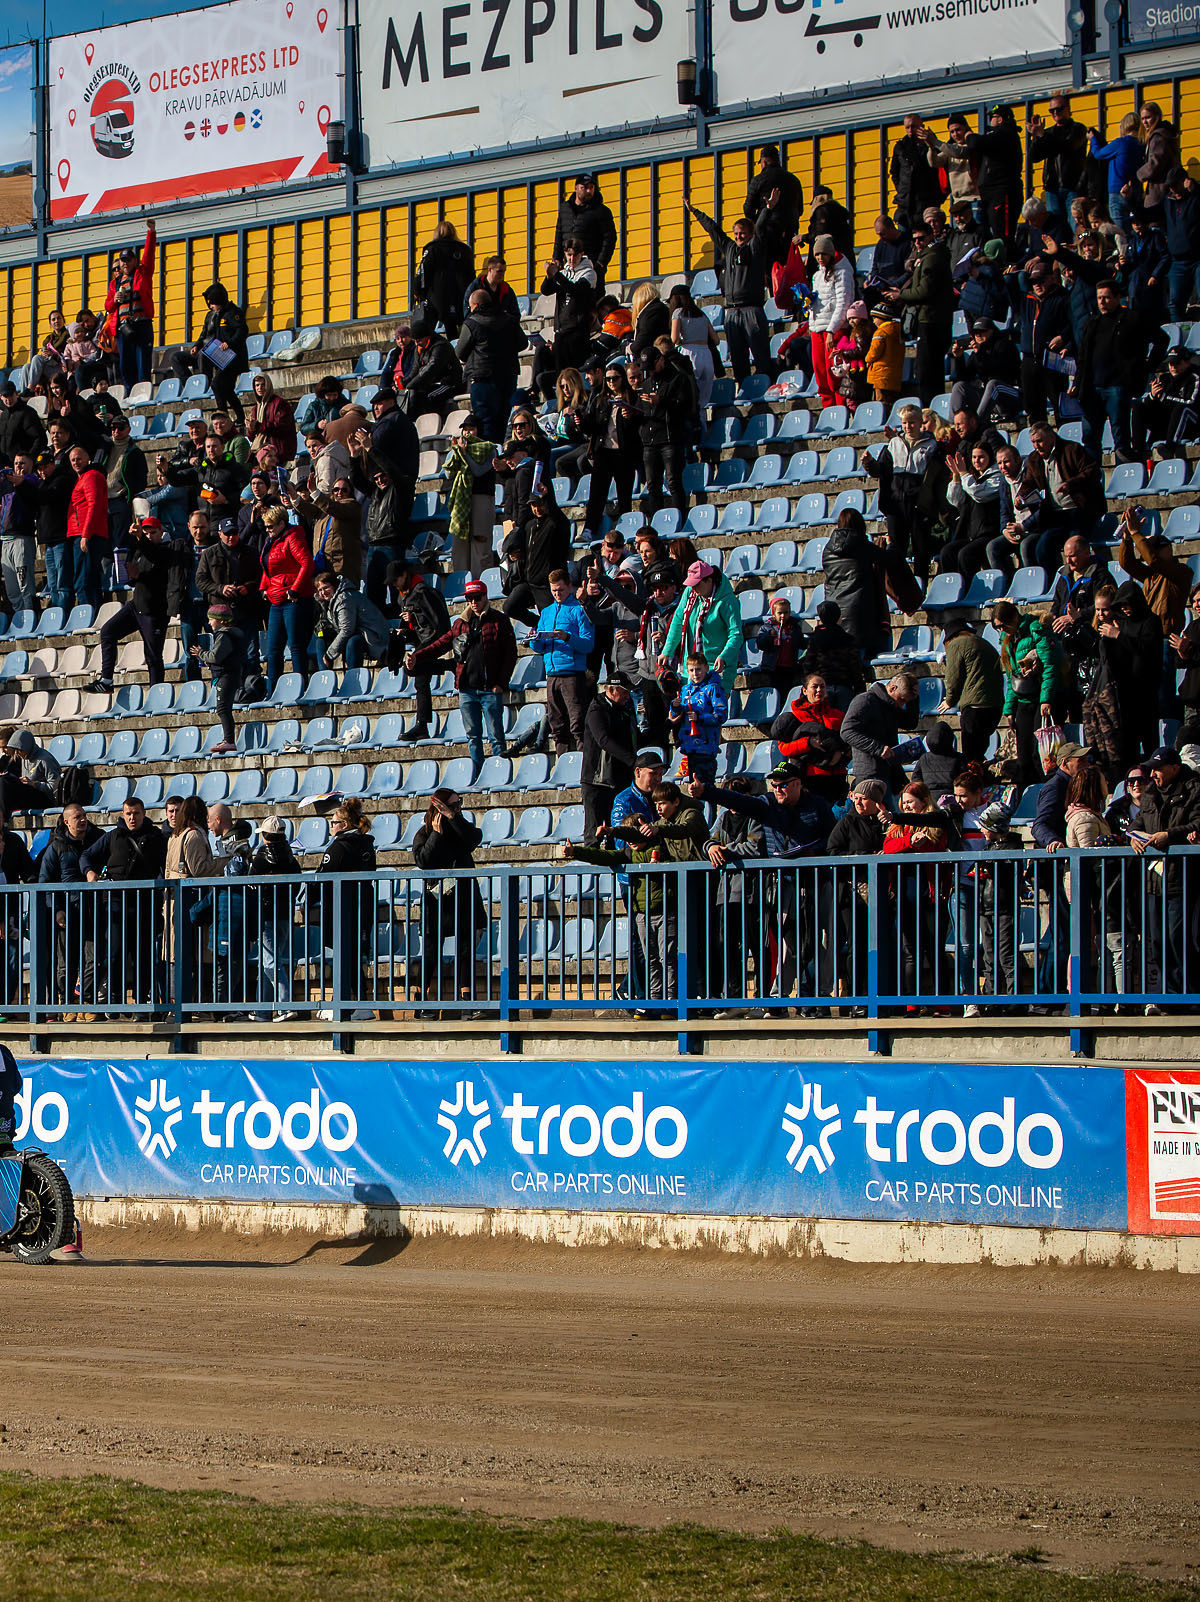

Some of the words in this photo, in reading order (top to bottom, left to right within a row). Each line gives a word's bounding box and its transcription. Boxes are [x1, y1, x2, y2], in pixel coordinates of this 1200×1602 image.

[382, 0, 663, 90] MEZPILS
[149, 50, 267, 93] OLEGSEXPRESS
[273, 45, 299, 69] LTD
[165, 94, 202, 117] KRAVU
[205, 79, 287, 109] PĀRVADĀJUMI
[191, 1088, 358, 1152] trodo
[500, 1091, 689, 1159] trodo
[853, 1096, 1064, 1169] trodo
[1153, 1141, 1179, 1155] MADE
[1182, 1141, 1191, 1156] IN
[200, 1163, 234, 1183] CAR
[238, 1164, 290, 1185] PARTS
[294, 1166, 357, 1187] ONLINE
[511, 1171, 548, 1192] CAR
[554, 1172, 613, 1194] PARTS
[617, 1174, 687, 1196] ONLINE
[865, 1180, 908, 1203] CAR
[915, 1182, 981, 1205] PARTS
[985, 1184, 1063, 1208] ONLINE
